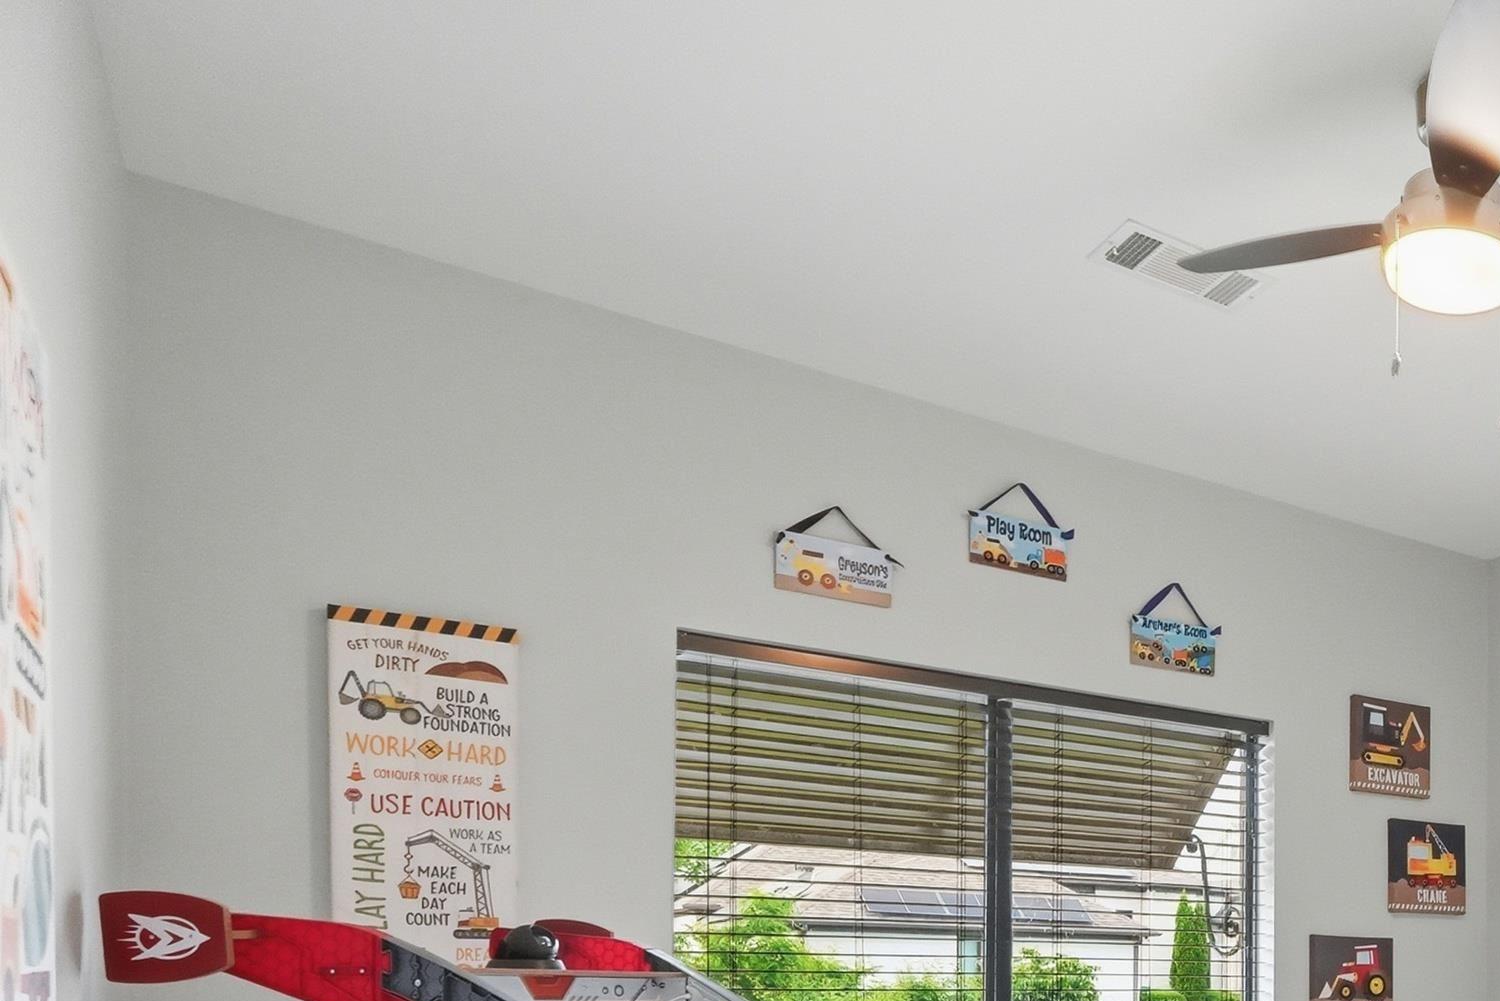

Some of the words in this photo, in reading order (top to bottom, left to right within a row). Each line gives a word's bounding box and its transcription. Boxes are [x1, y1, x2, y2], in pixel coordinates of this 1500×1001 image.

[986, 515, 1015, 541] Play
[1019, 523, 1052, 546] Room
[838, 556, 889, 579] Greyson's
[347, 638, 369, 650] GET
[371, 638, 404, 650] YOUR
[407, 641, 449, 661] HANDS
[375, 654, 420, 673] DIRTY
[436, 686, 475, 704] BUILD
[479, 692, 489, 705] A
[445, 703, 501, 722] STRONG
[423, 716, 511, 737] FOUNDATION
[345, 732, 417, 759] WORK
[447, 740, 507, 767] HARD
[373, 768, 421, 783] CONQUER
[423, 773, 449, 785] YOUR
[451, 775, 483, 787] FEARS
[1368, 767, 1421, 788] EXCAVATOR
[370, 793, 413, 815] USE
[420, 797, 512, 821] CAUTION
[449, 828, 484, 841] WORK
[487, 830, 503, 841] AS
[352, 823, 386, 884] HARD
[469, 842, 477, 853] A
[481, 843, 511, 855] TEAM
[417, 865, 457, 880] MAKE
[430, 881, 467, 896] EACH
[1417, 888, 1448, 904] CRANE
[355, 889, 388, 930] LAY
[421, 897, 447, 910] DAY
[405, 911, 451, 926] COUNT
